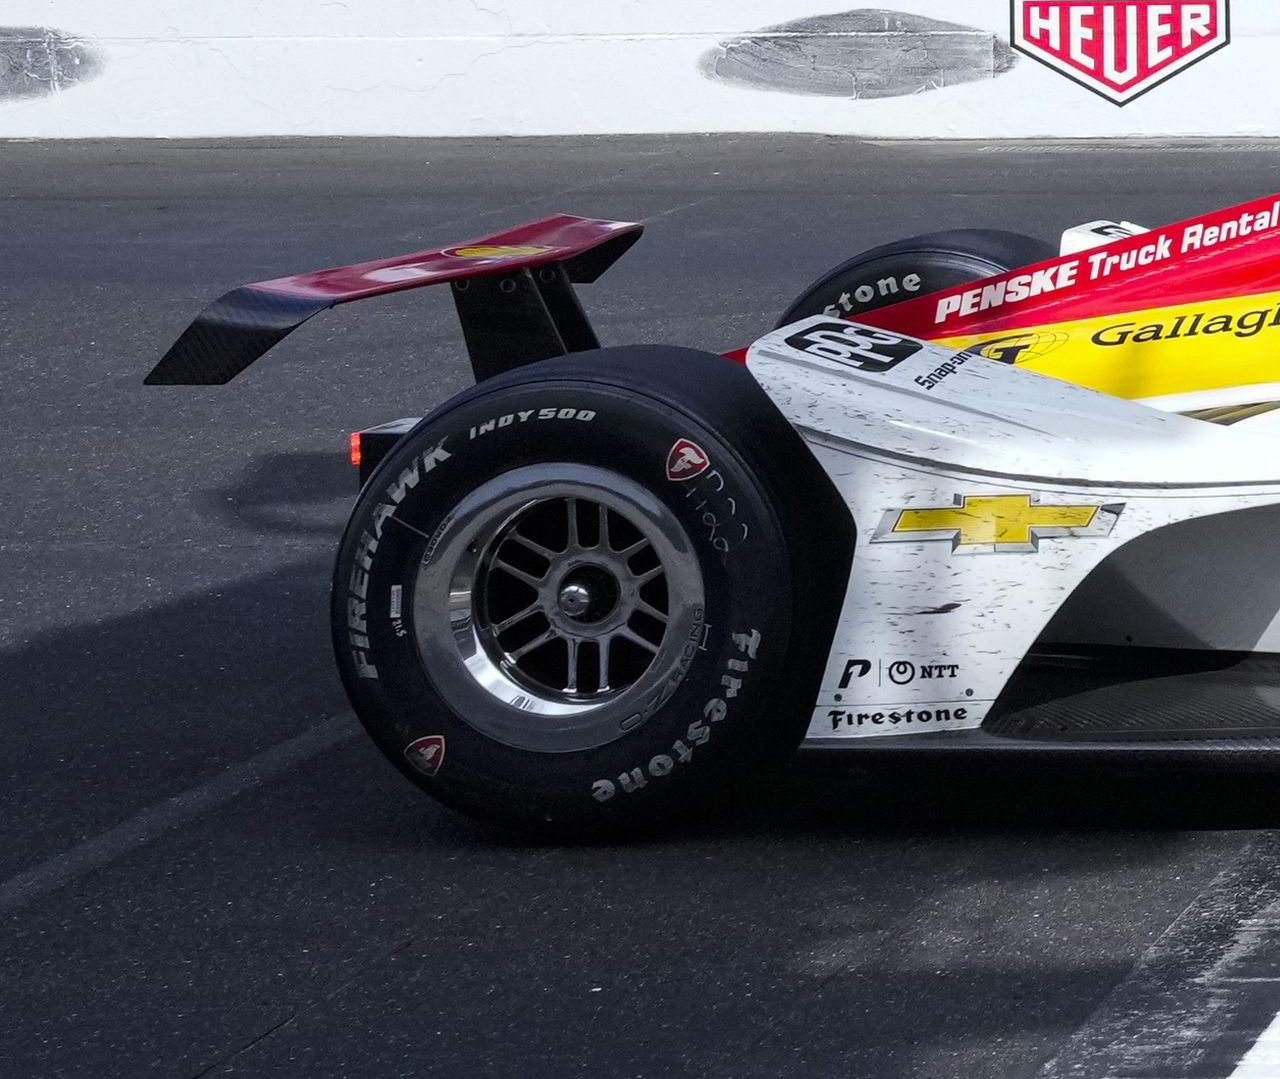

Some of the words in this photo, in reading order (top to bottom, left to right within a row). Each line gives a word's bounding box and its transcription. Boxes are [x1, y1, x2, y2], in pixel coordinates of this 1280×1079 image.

[1029, 3, 1211, 86] HEUER
[934, 260, 1080, 324] PENSKE
[1088, 233, 1172, 280] Truck
[914, 350, 973, 391] Snap-on
[470, 408, 535, 440] INDY
[537, 406, 598, 423] 500
[346, 433, 453, 681] FIREHAWK
[919, 664, 960, 680] NTT
[591, 629, 762, 802] Firestone
[827, 706, 969, 730] Firestone
